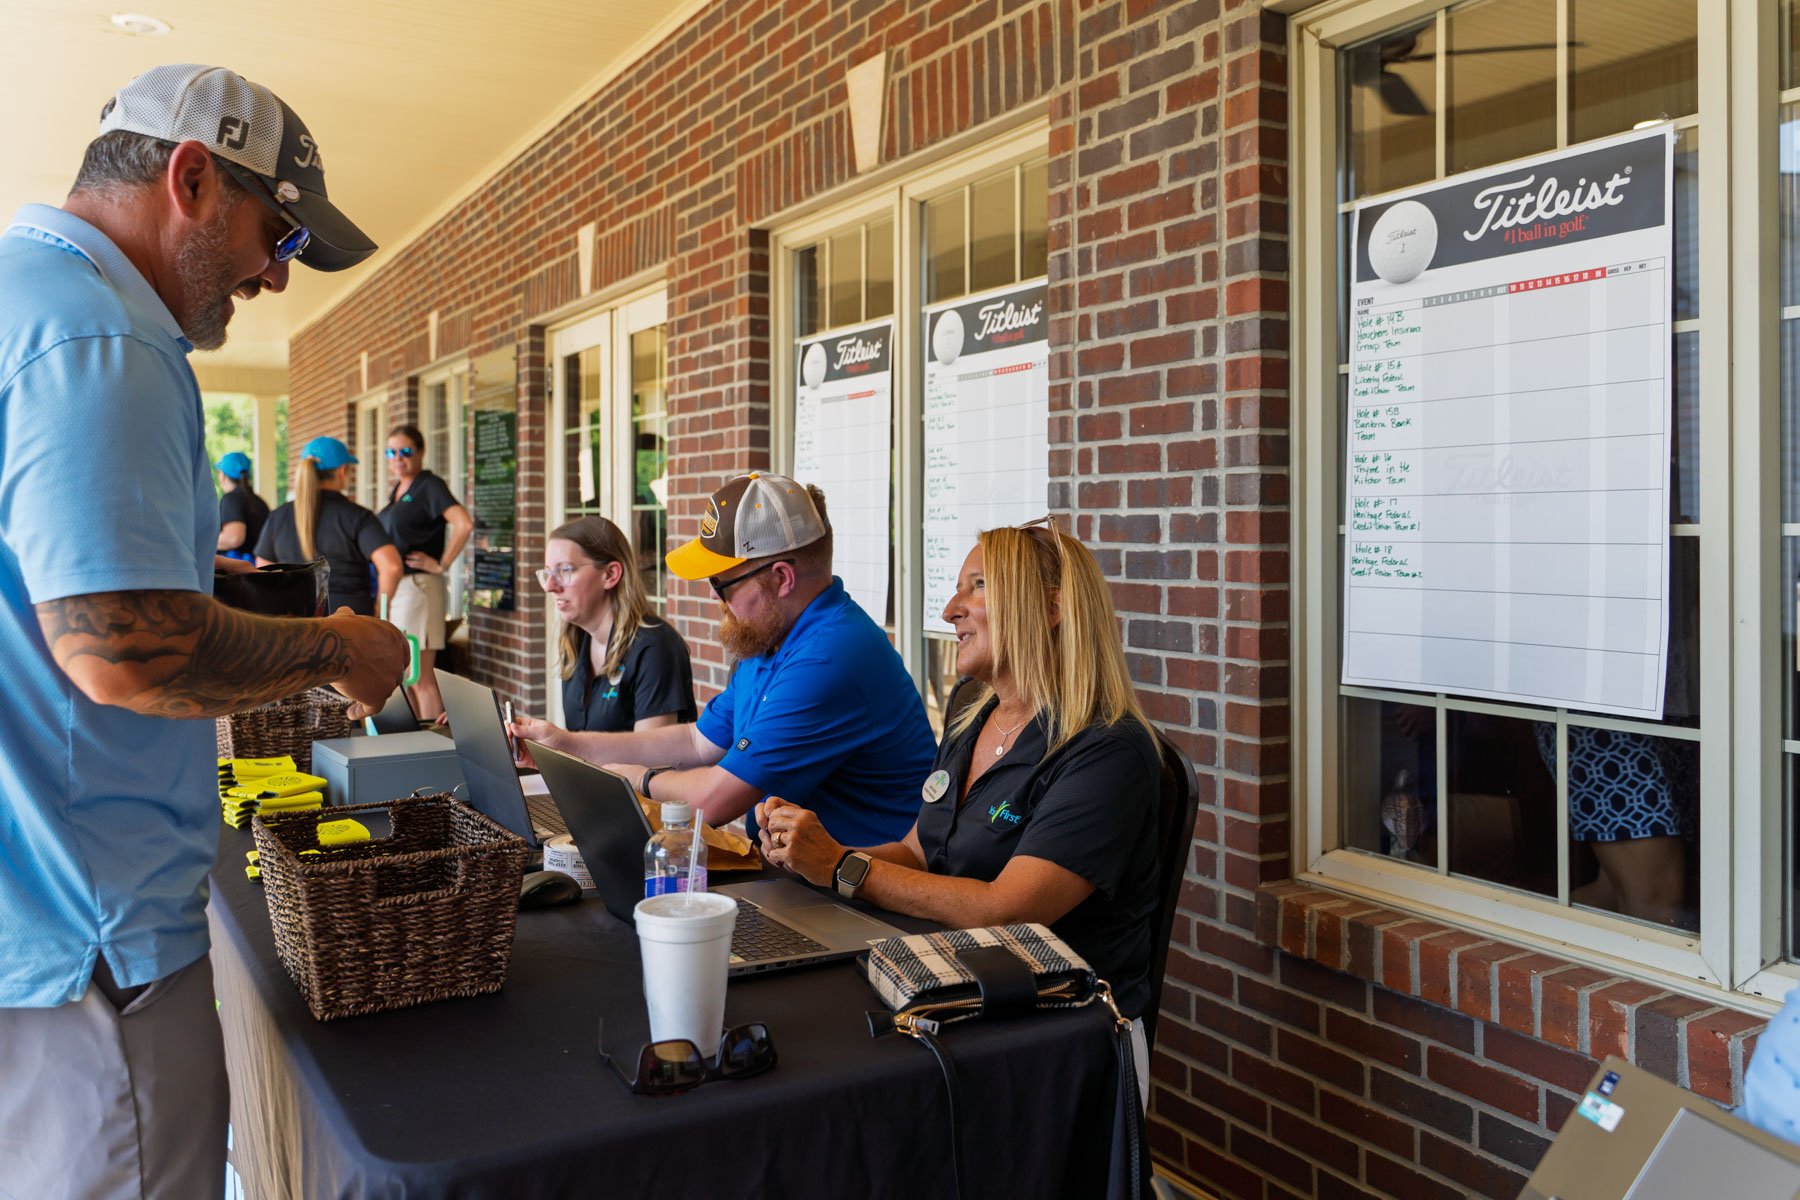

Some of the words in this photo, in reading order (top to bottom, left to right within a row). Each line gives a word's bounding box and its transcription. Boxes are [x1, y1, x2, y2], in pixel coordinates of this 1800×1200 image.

[1463, 173, 1631, 242] Titleist
[1518, 223, 1541, 243] ball
[1544, 222, 1557, 238] in
[1358, 297, 1374, 306] EVENT
[974, 300, 1042, 340] Titleist
[1357, 316, 1373, 328] Hole
[833, 336, 882, 370] Titleist
[1357, 364, 1372, 372] Hole
[1356, 408, 1370, 418] Hole
[1390, 418, 1412, 428] Bank
[1354, 430, 1376, 440] Team
[1354, 454, 1368, 464] Hole
[1386, 464, 1394, 474] in
[1400, 462, 1410, 472] the
[1386, 476, 1406, 484] Team
[1354, 498, 1370, 508] Hole
[1353, 510, 1382, 520] Heritage
[1386, 510, 1412, 519] Federal
[1355, 543, 1372, 554] Hole
[1352, 556, 1378, 569] Heritage
[1382, 556, 1408, 566] Federal
[1394, 569, 1410, 578] Team
